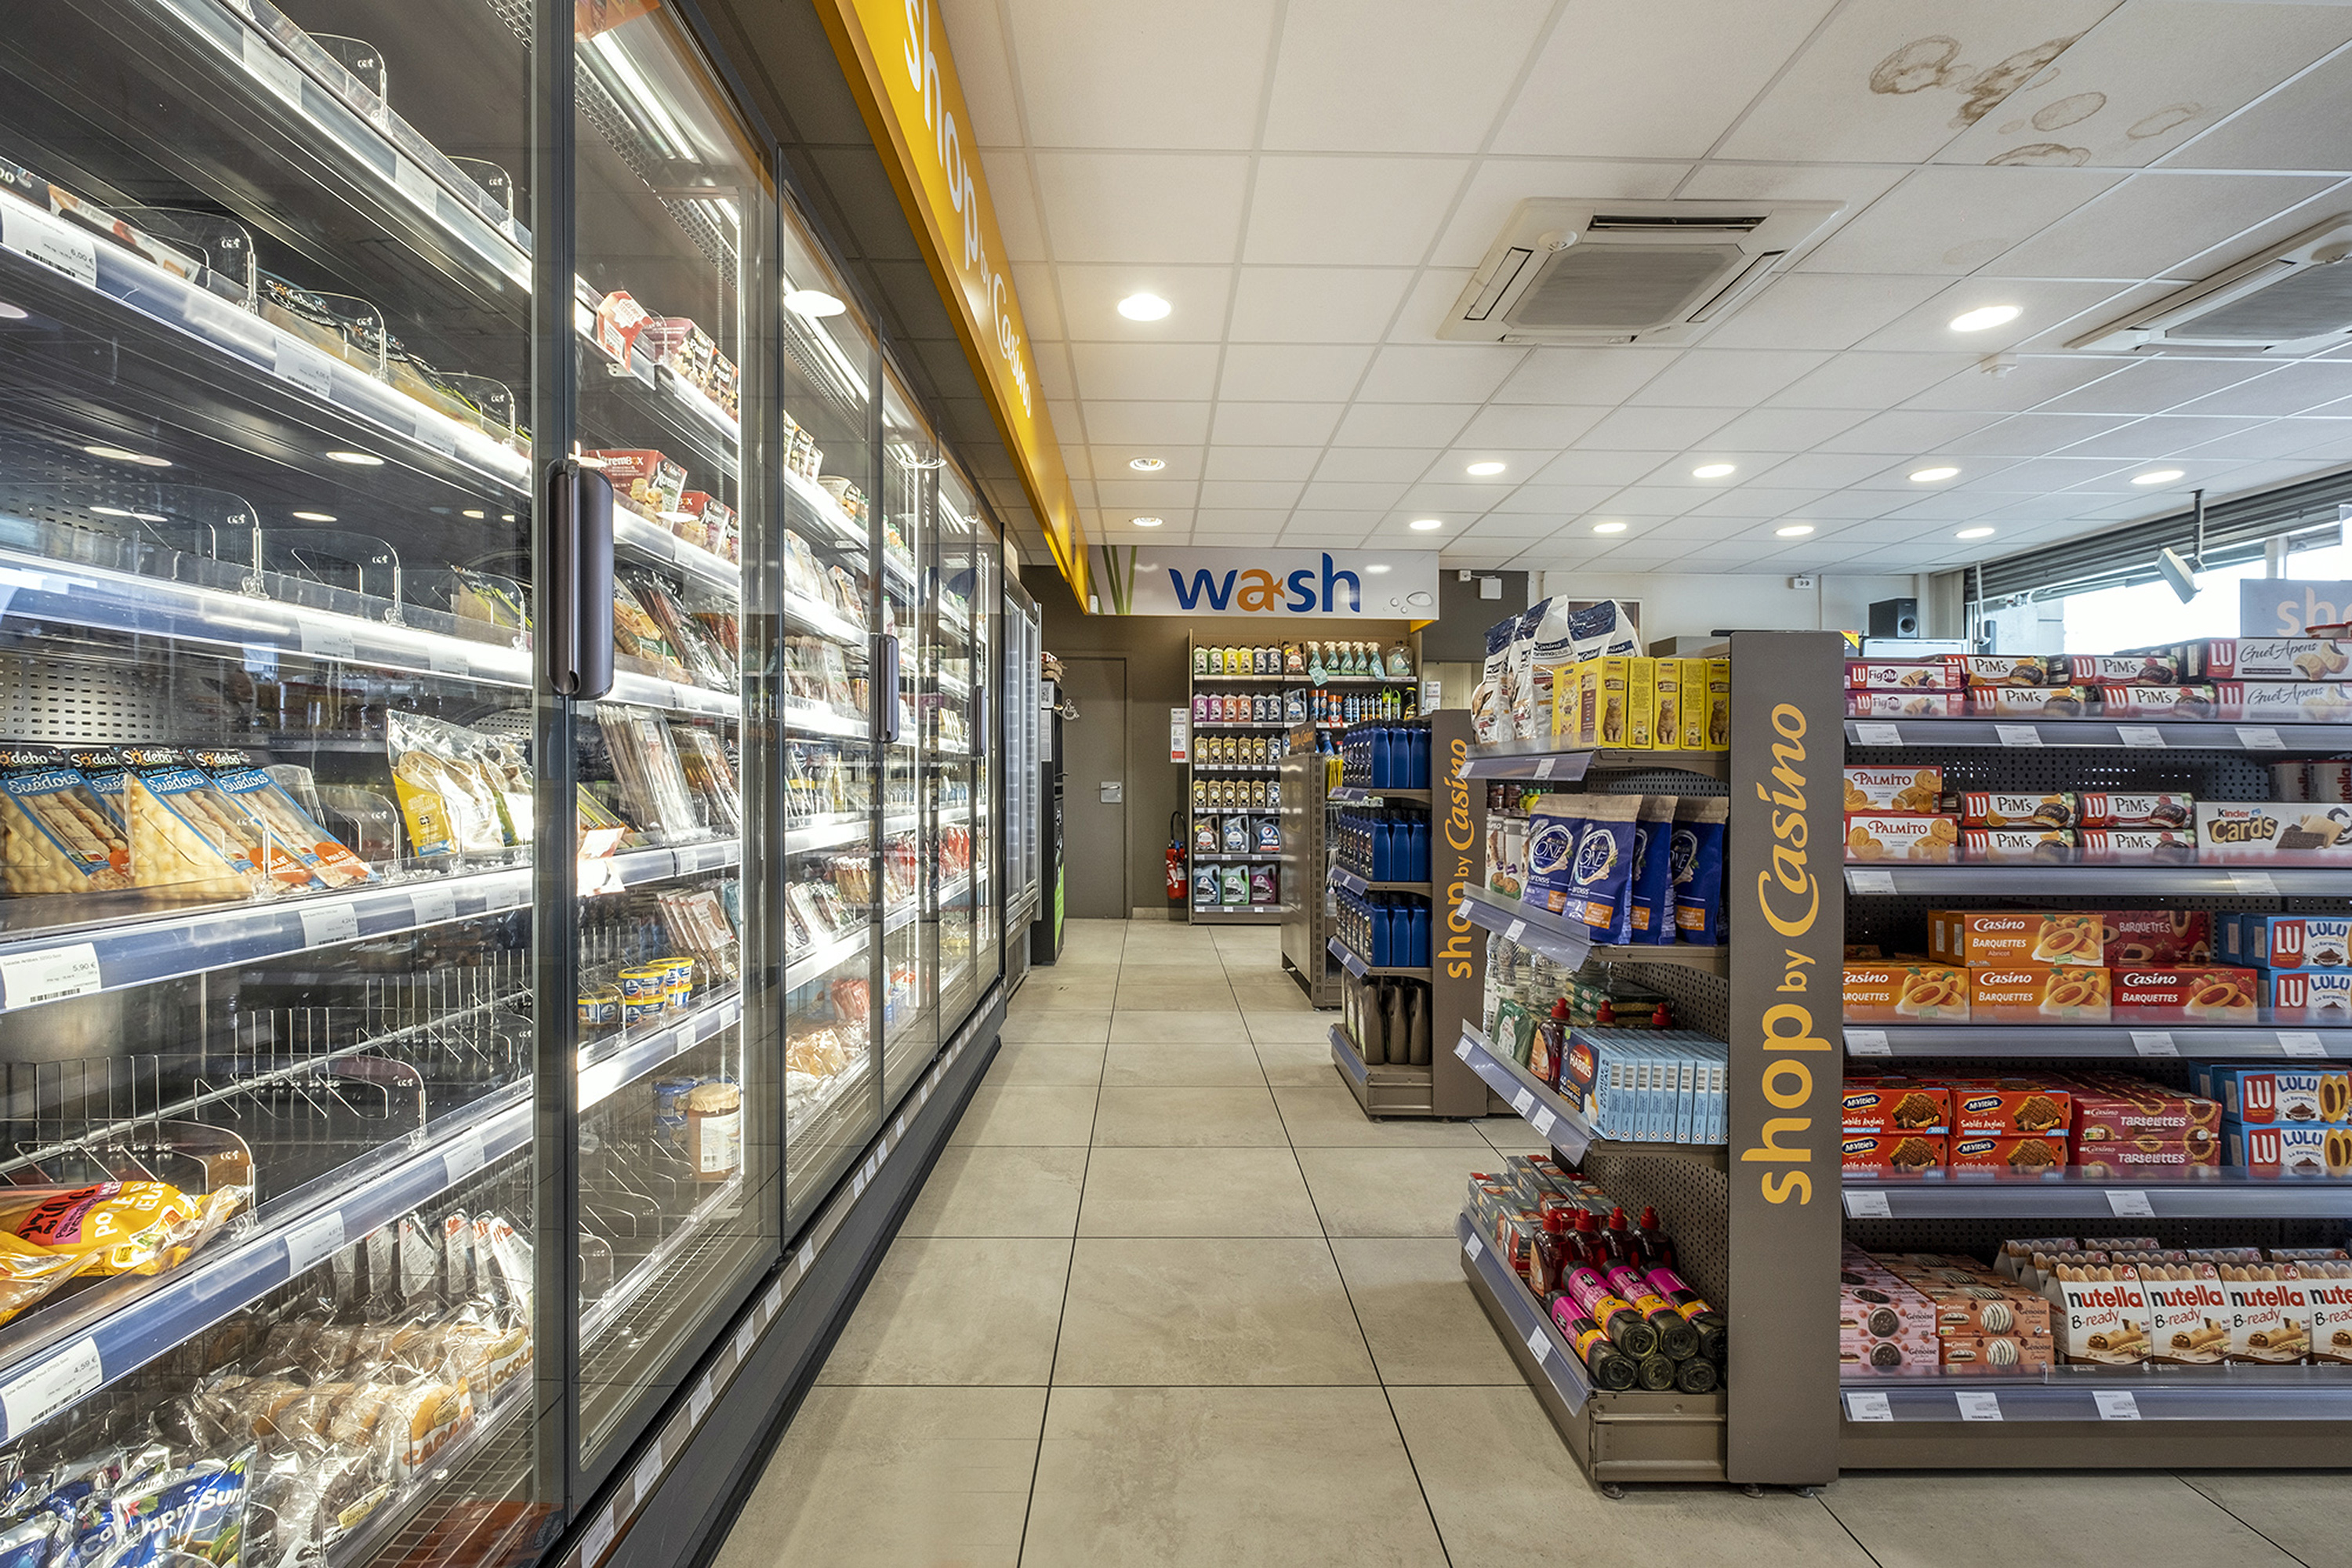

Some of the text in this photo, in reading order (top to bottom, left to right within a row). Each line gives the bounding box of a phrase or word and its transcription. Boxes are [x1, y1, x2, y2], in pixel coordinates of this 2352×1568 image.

[993, 273, 1032, 419] Casino
[1167, 552, 1361, 613] wash
[2276, 586, 2352, 637] sh
[2211, 643, 2233, 666] LU
[1852, 666, 1866, 683] LU
[2073, 657, 2093, 679] LU
[1856, 695, 1871, 710] LU
[1975, 689, 1996, 711] LU
[2105, 688, 2127, 710] LU
[71, 752, 118, 768] Sodeb
[147, 772, 205, 793] Suédois
[1968, 796, 1987, 817] LU
[2087, 797, 2107, 818] LU
[2211, 816, 2275, 844] Cards
[1534, 841, 1565, 859] ONE
[1454, 855, 1473, 877] by
[1973, 917, 2026, 932] Casino
[2118, 921, 2172, 934] BARQUETTES
[2307, 922, 2348, 938] LULU
[1972, 938, 2027, 949] BARQUETTES
[2276, 926, 2300, 954] LU
[1740, 702, 1833, 1206] shop by Casino
[72, 963, 89, 972] 5,90
[1842, 971, 1889, 985] Casino
[1980, 971, 2033, 986] Casino
[2123, 971, 2177, 987] Casino
[2310, 975, 2350, 992] LULU
[1842, 992, 1890, 1001] ARQUETTES
[1978, 991, 2034, 1002] BARQUETTES
[2122, 993, 2179, 1003] BARQUETTES
[2279, 979, 2303, 1007] LU
[1570, 1052, 1592, 1080] HARRIS
[2246, 1080, 2271, 1109] LU
[2277, 1076, 2318, 1093] LULU
[2251, 1134, 2278, 1163] LU
[2282, 1131, 2324, 1147] LULU
[2067, 1286, 2144, 1308] nutella
[2150, 1284, 2225, 1307] nutella
[2230, 1285, 2306, 1308] nutella
[2071, 1308, 2120, 1330] B-ready
[2154, 1308, 2201, 1329] B-ready
[2233, 1308, 2281, 1328] B-ready
[74, 1360, 90, 1374] 4,59
